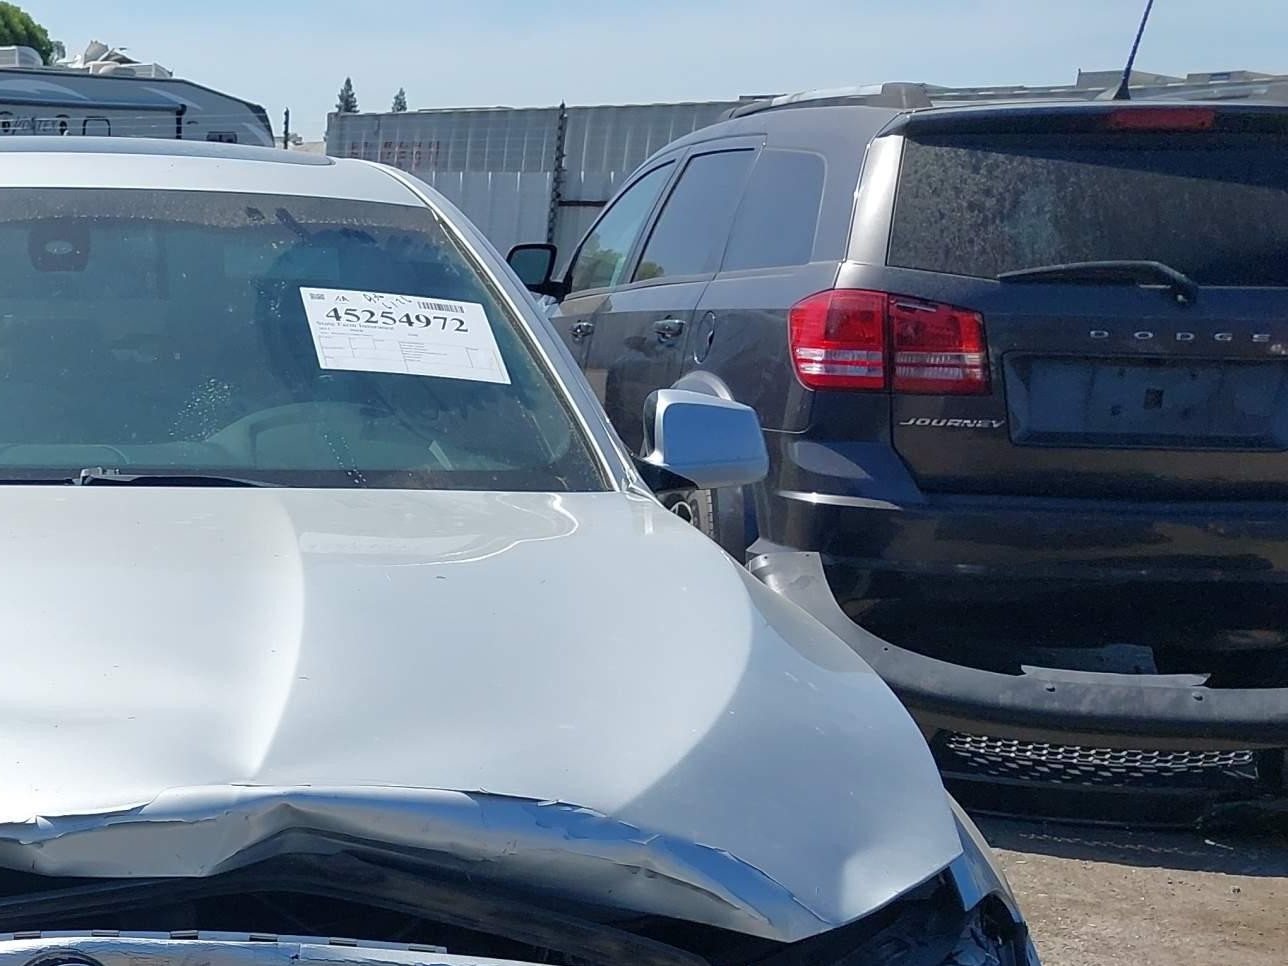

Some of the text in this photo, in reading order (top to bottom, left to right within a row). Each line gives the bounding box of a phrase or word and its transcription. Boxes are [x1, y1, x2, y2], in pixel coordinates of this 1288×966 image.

[325, 306, 469, 333] 45254972
[1089, 330, 1271, 343] DODGE
[899, 417, 1006, 429] JOURNEY
